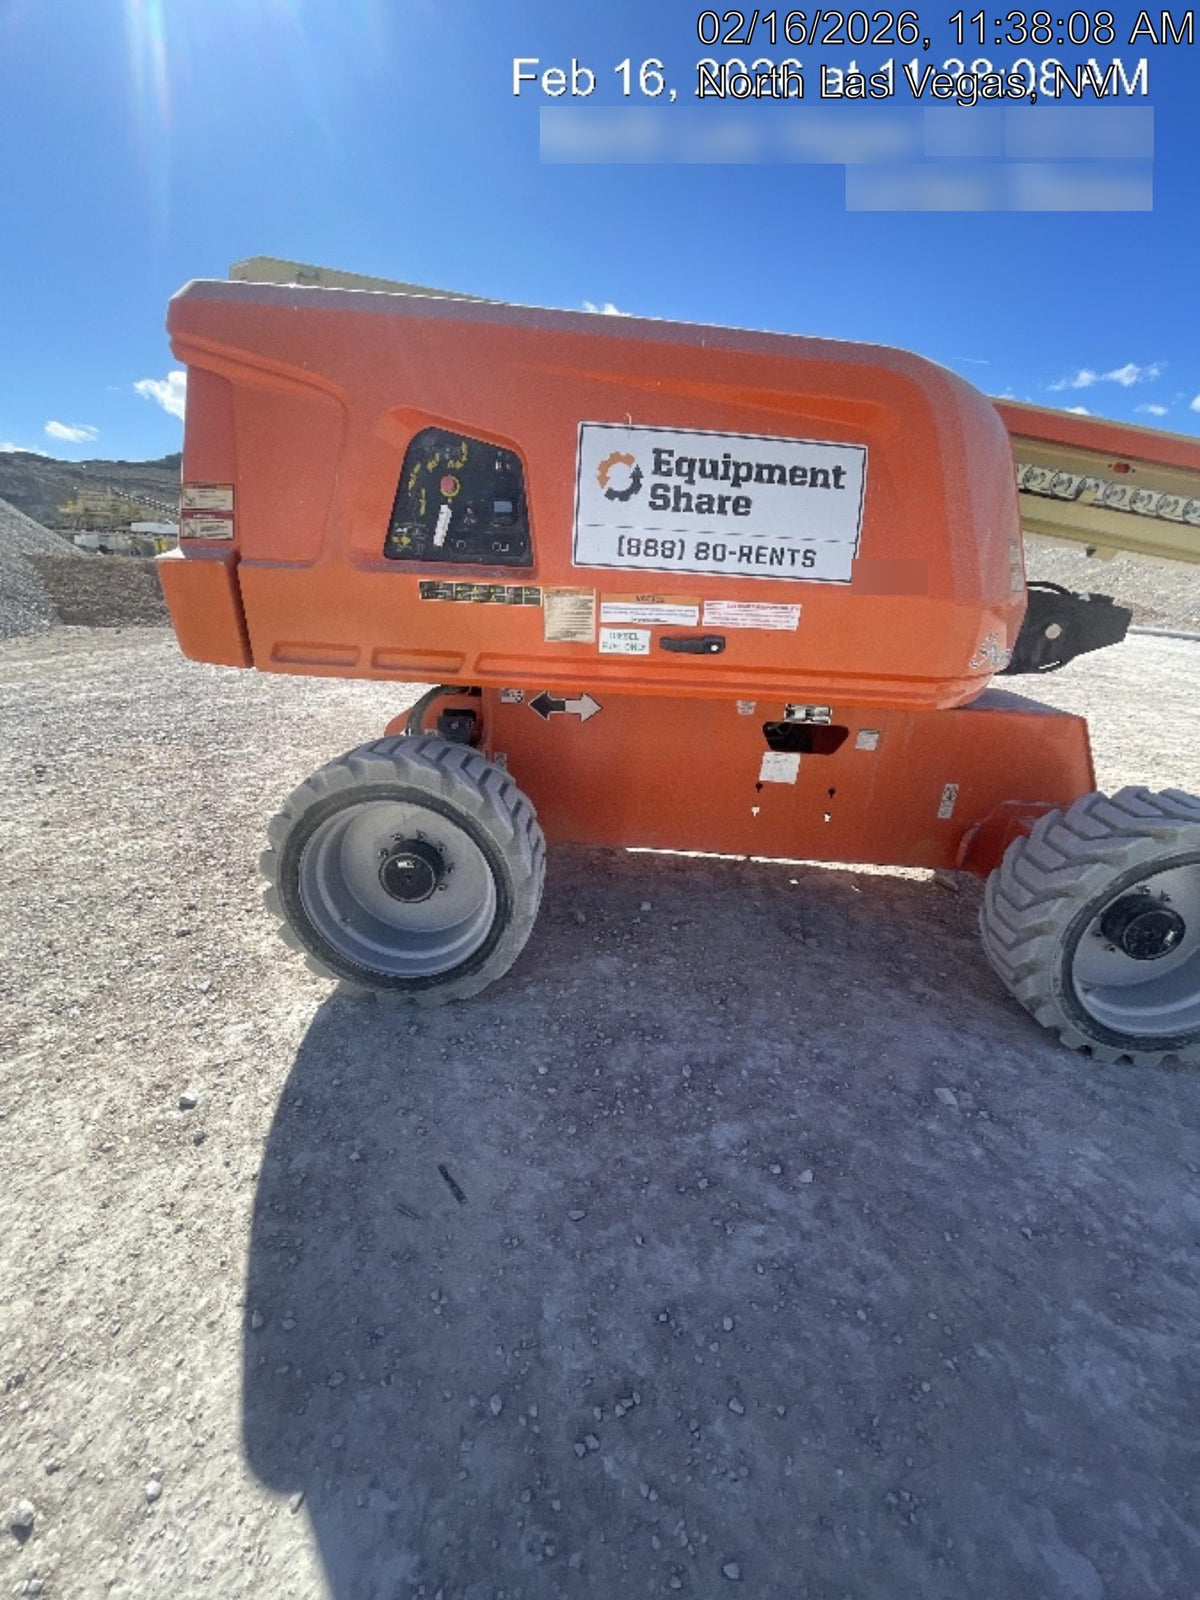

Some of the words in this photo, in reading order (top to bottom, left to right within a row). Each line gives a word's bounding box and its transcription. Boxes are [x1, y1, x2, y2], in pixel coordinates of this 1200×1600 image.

[651, 448, 847, 490] Equipment
[648, 483, 752, 516] Share
[617, 535, 686, 561] (888)
[694, 541, 817, 568] 80-RENTS
